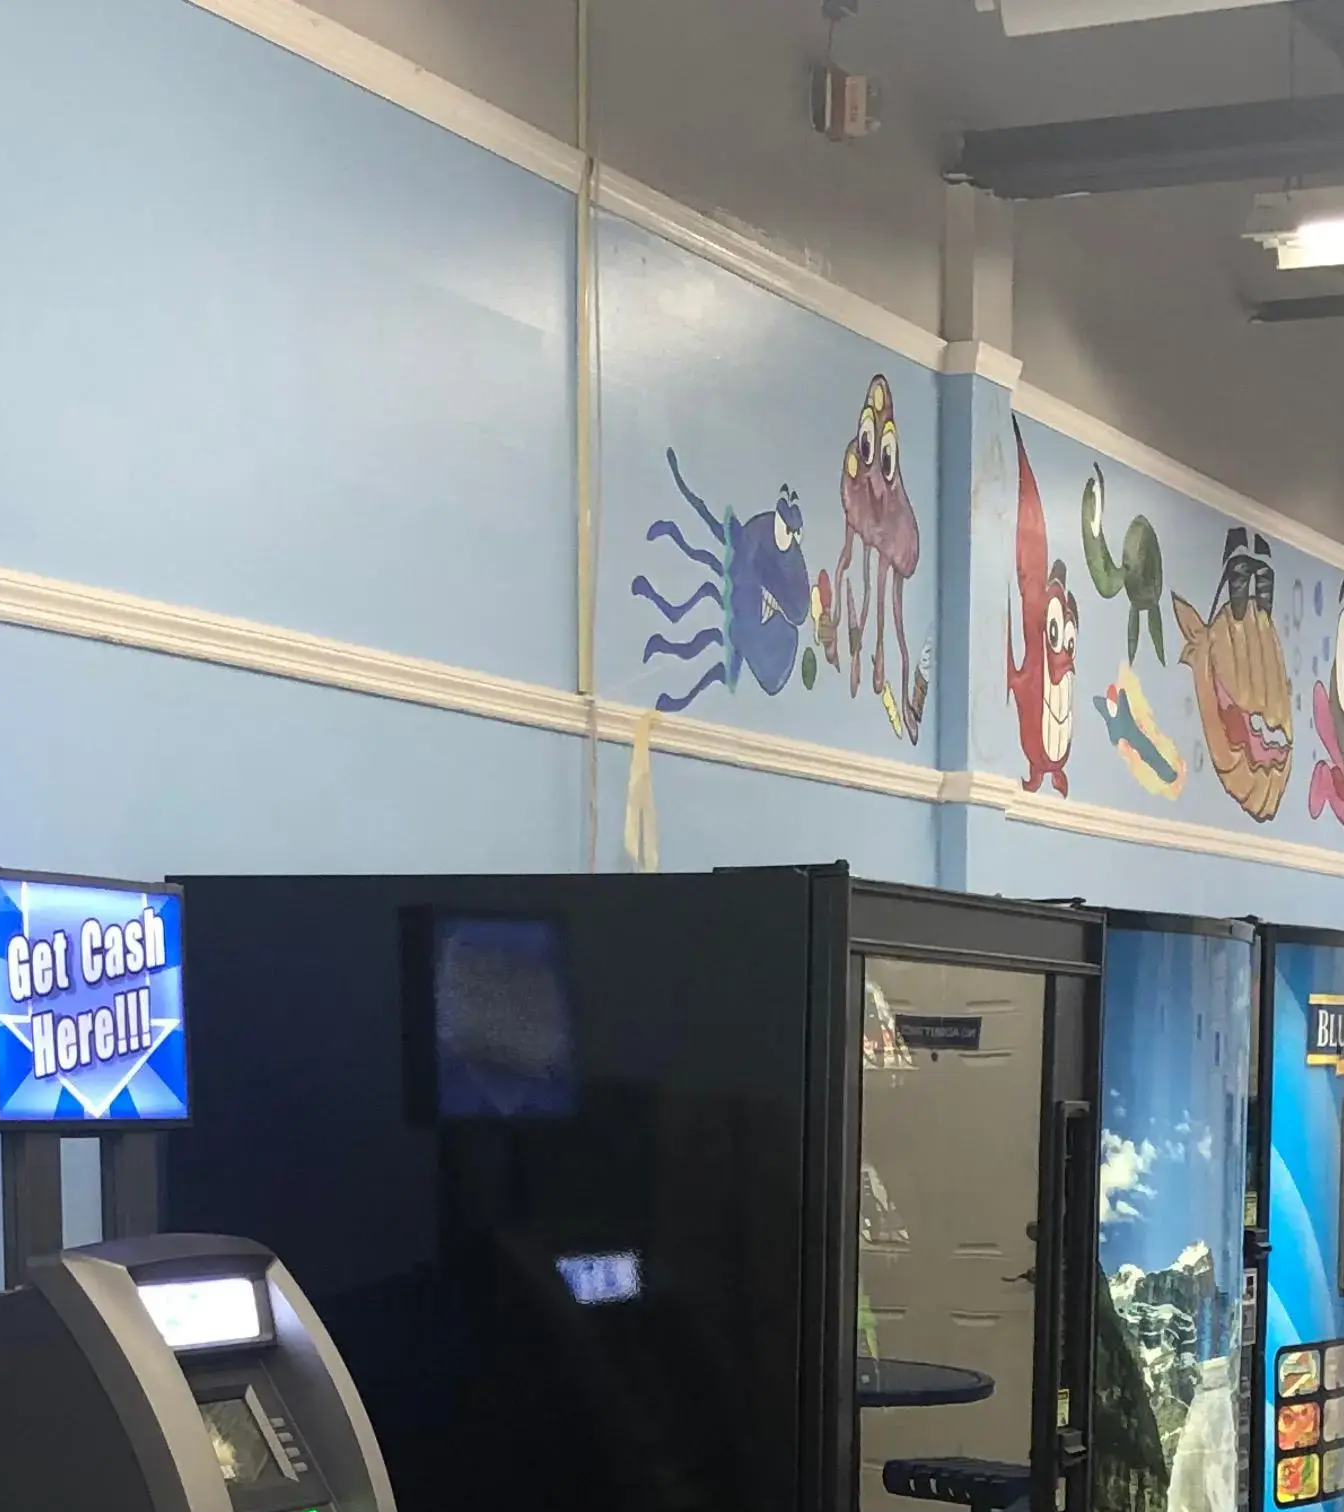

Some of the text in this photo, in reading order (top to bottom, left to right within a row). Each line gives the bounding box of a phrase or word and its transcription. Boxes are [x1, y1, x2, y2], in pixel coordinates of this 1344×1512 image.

[8, 908, 165, 1002] Get Cash
[32, 988, 151, 1079] Here!!!
